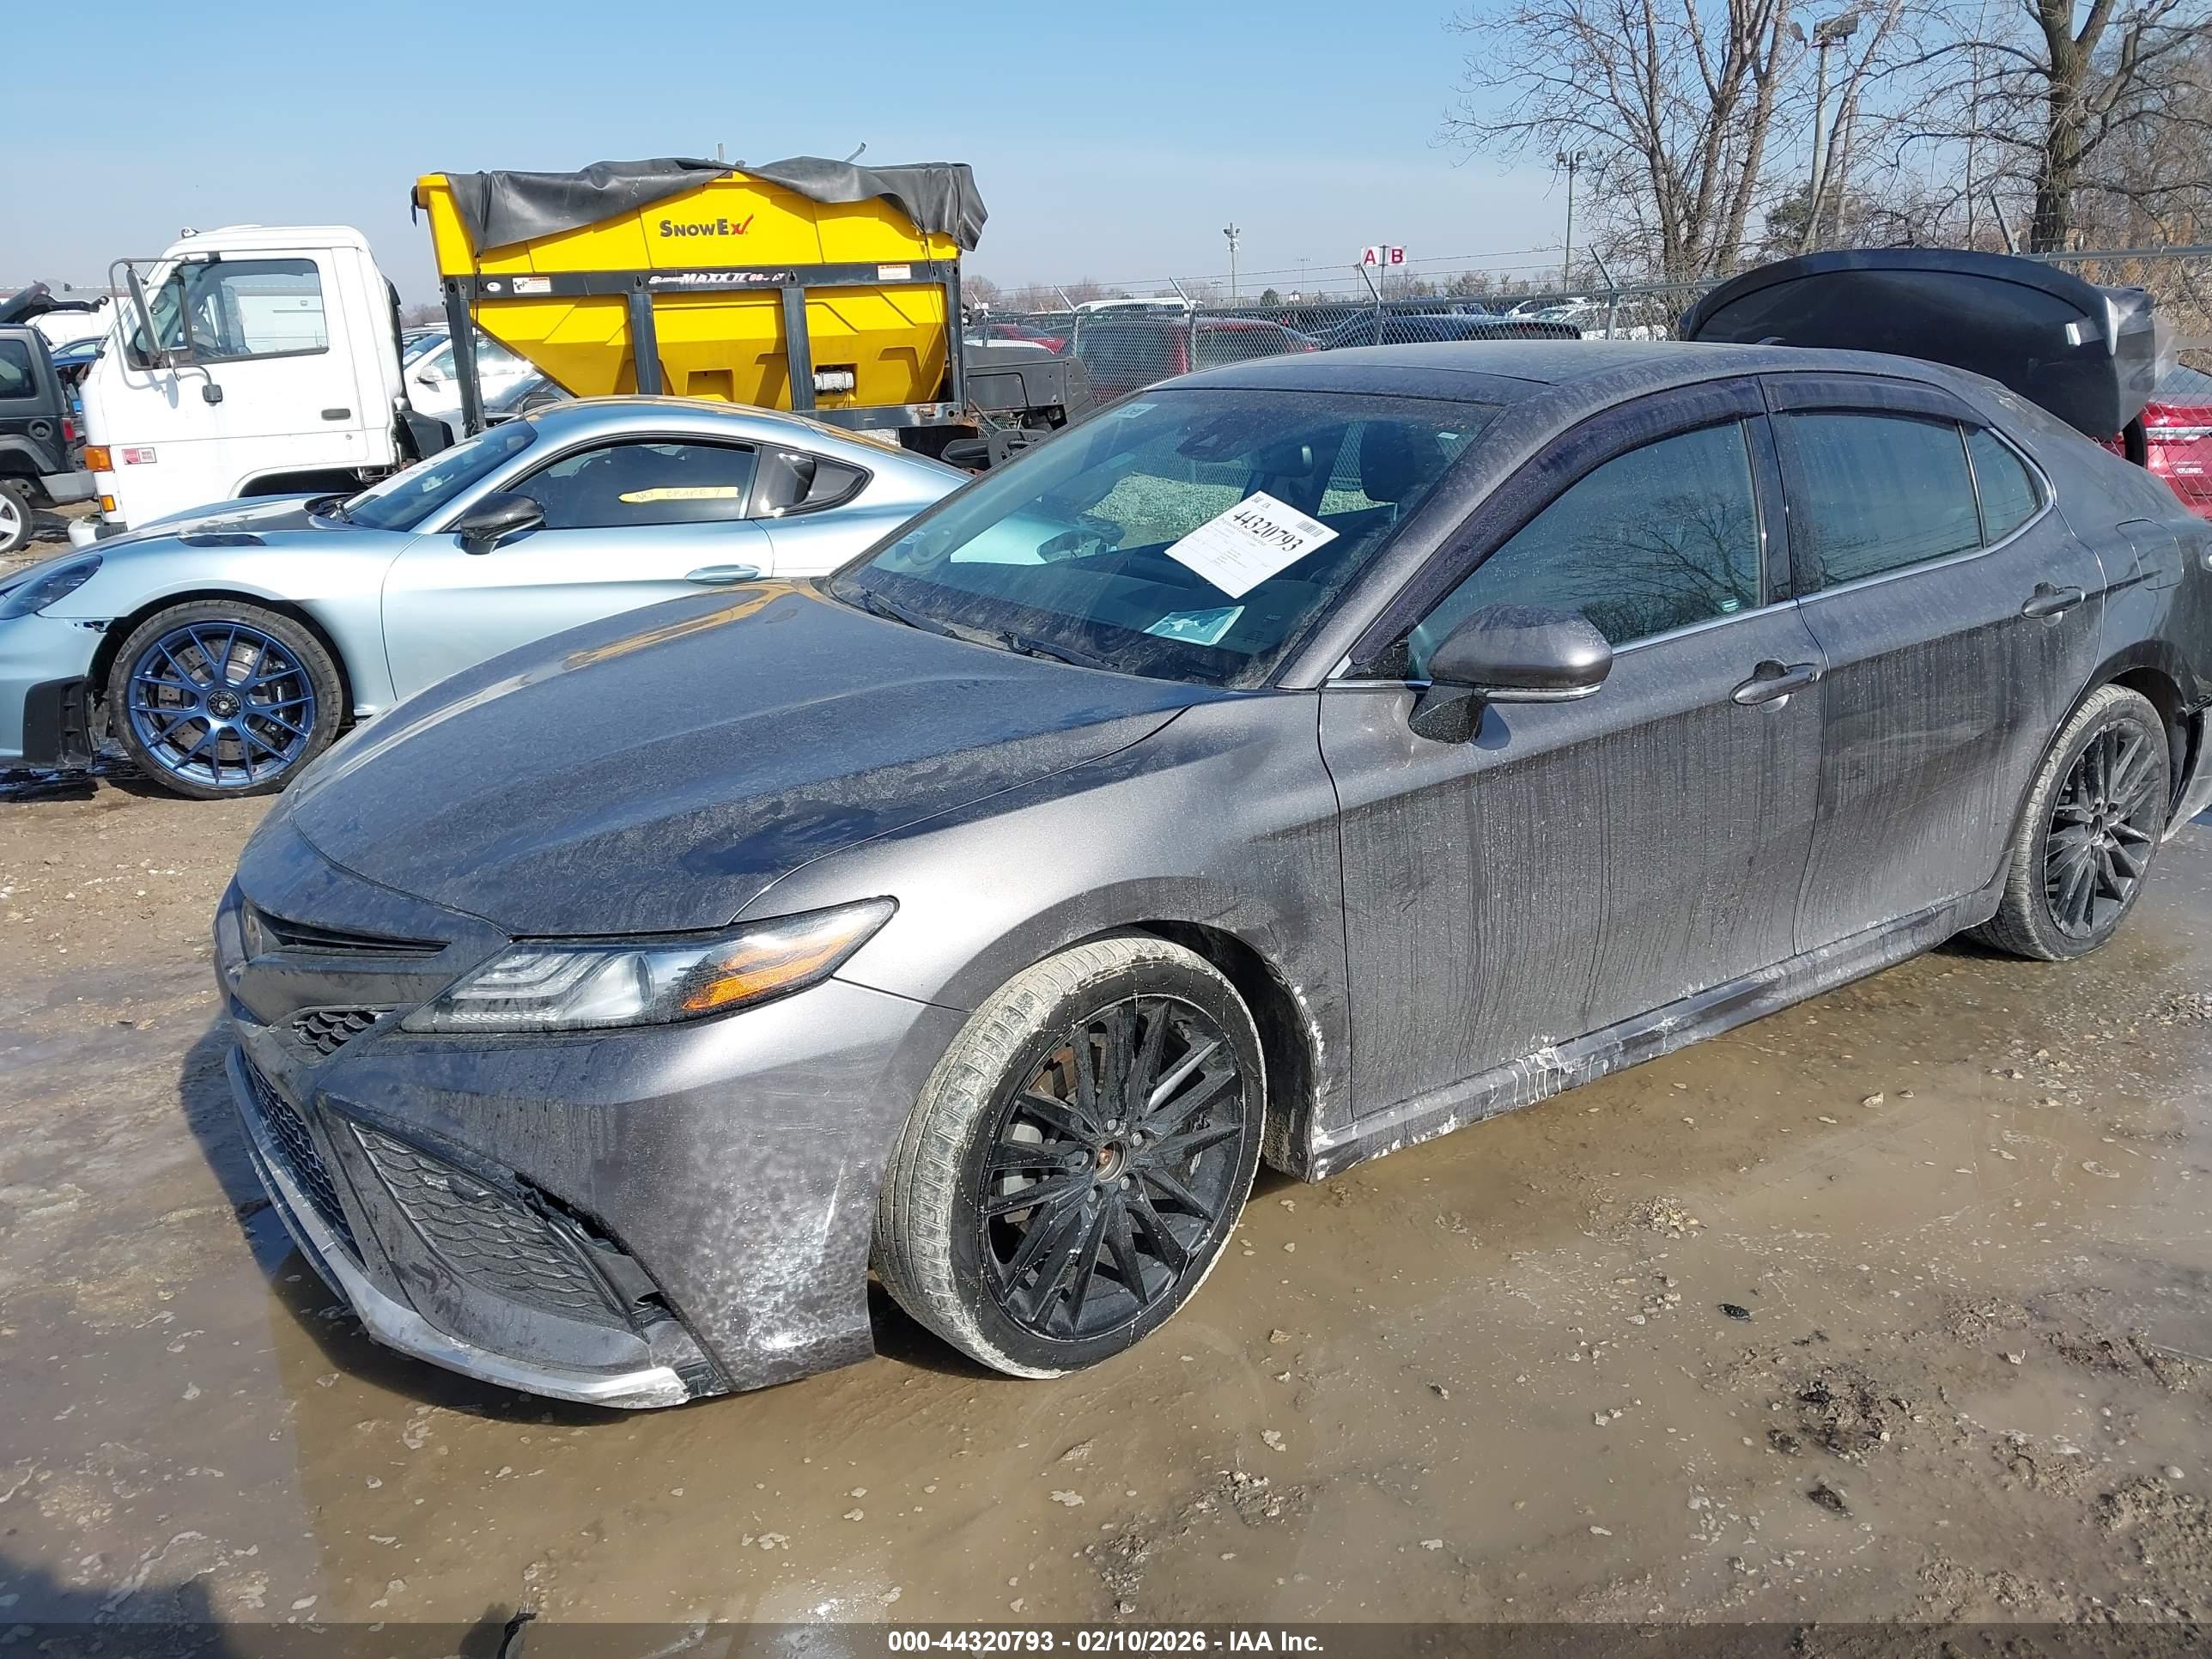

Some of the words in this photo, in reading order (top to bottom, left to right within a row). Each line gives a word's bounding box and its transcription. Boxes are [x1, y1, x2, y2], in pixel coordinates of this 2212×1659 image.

[1364, 249, 1376, 265] A
[1391, 248, 1404, 264] B
[1233, 510, 1304, 551] 44320793
